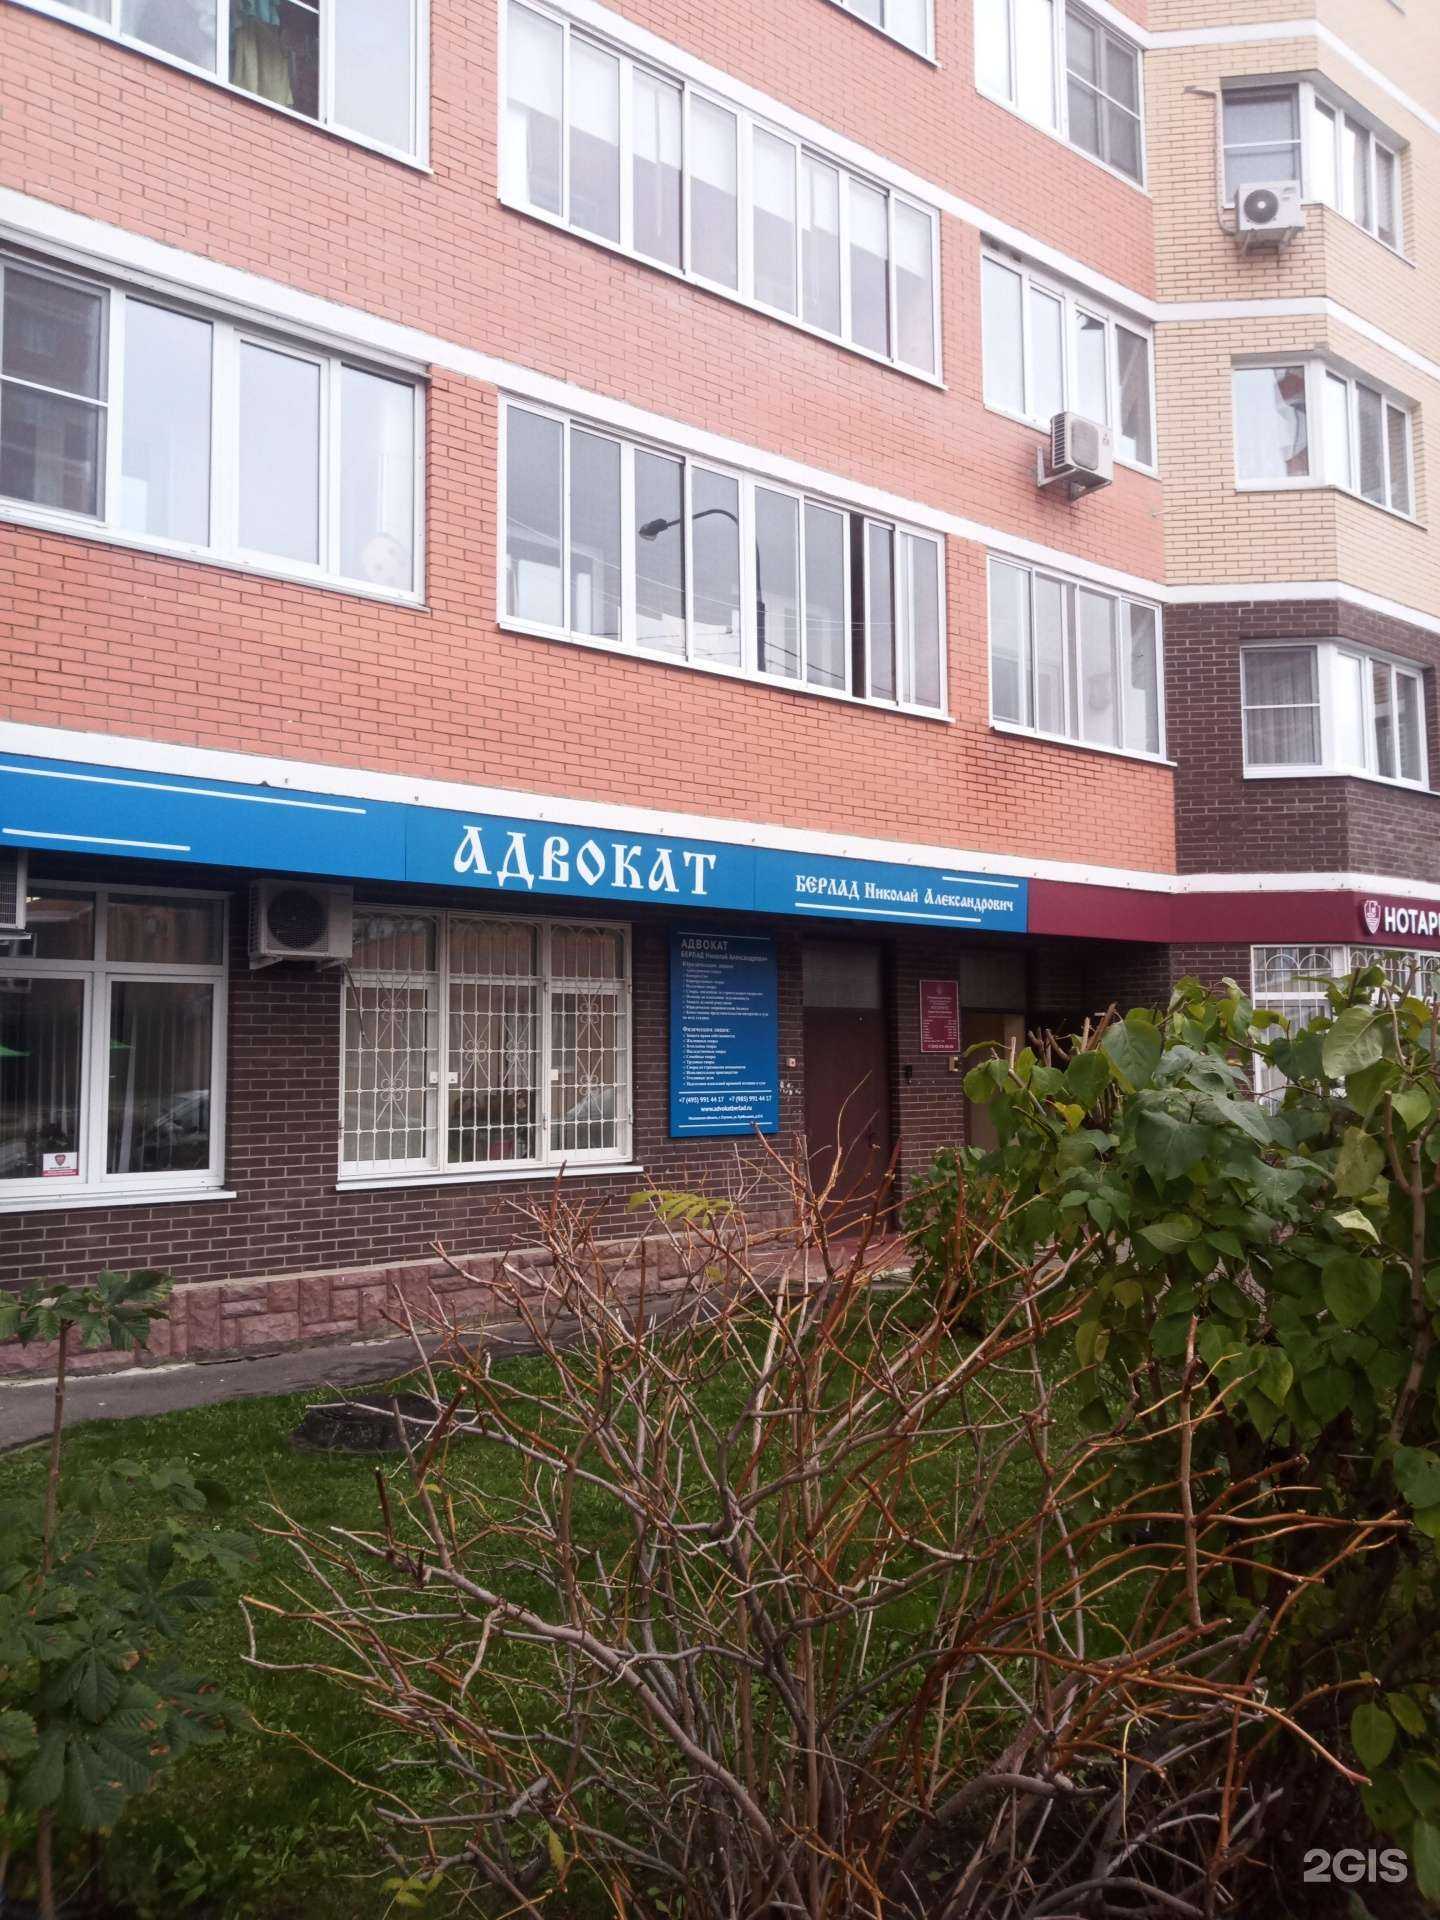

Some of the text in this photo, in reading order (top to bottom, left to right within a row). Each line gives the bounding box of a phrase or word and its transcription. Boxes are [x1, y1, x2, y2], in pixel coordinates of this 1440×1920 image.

[453, 825, 717, 895] АДВОКАТ
[795, 874, 1014, 913] БЕРЛАД Николай Александрович
[681, 938, 728, 950] АДВОКАТ
